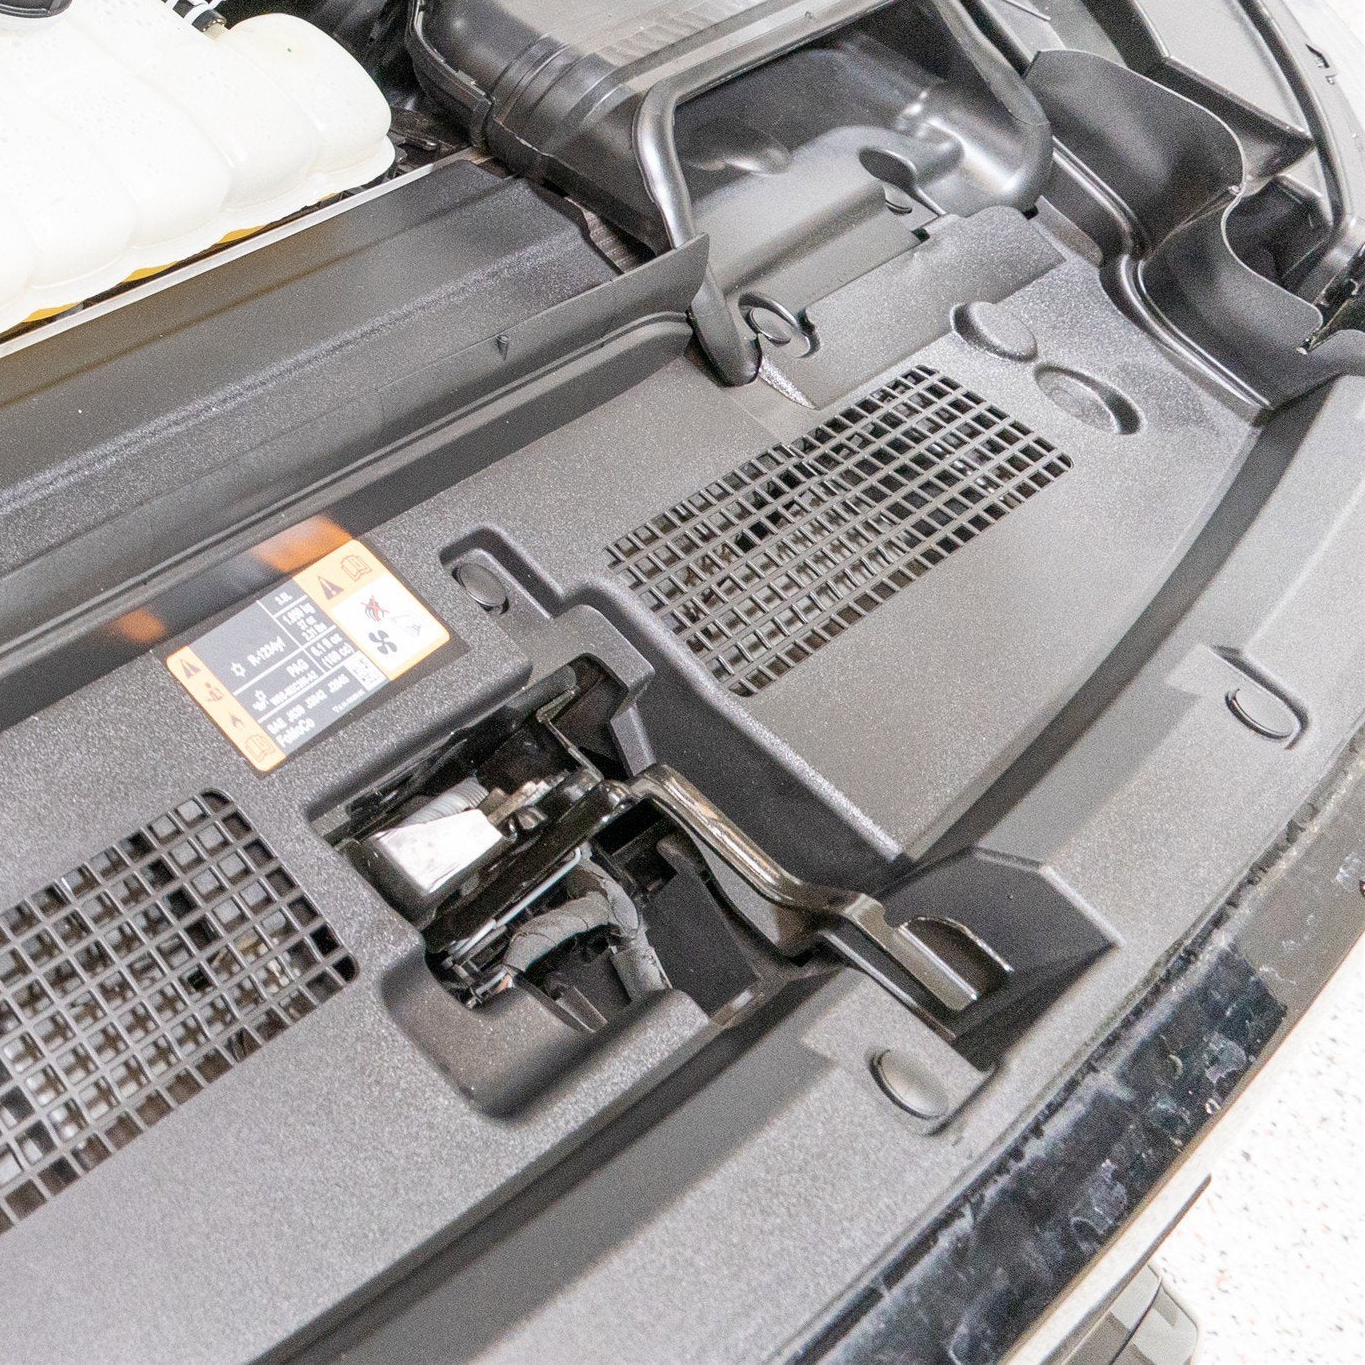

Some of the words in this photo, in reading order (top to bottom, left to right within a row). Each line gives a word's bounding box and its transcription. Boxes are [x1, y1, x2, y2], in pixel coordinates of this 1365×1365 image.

[246, 635, 288, 667] R-1234yf
[321, 637, 333, 649] fl
[328, 632, 343, 645] oz
[285, 657, 310, 678] PAG
[265, 716, 288, 736] SAE
[274, 715, 317, 748] FoMoCo
